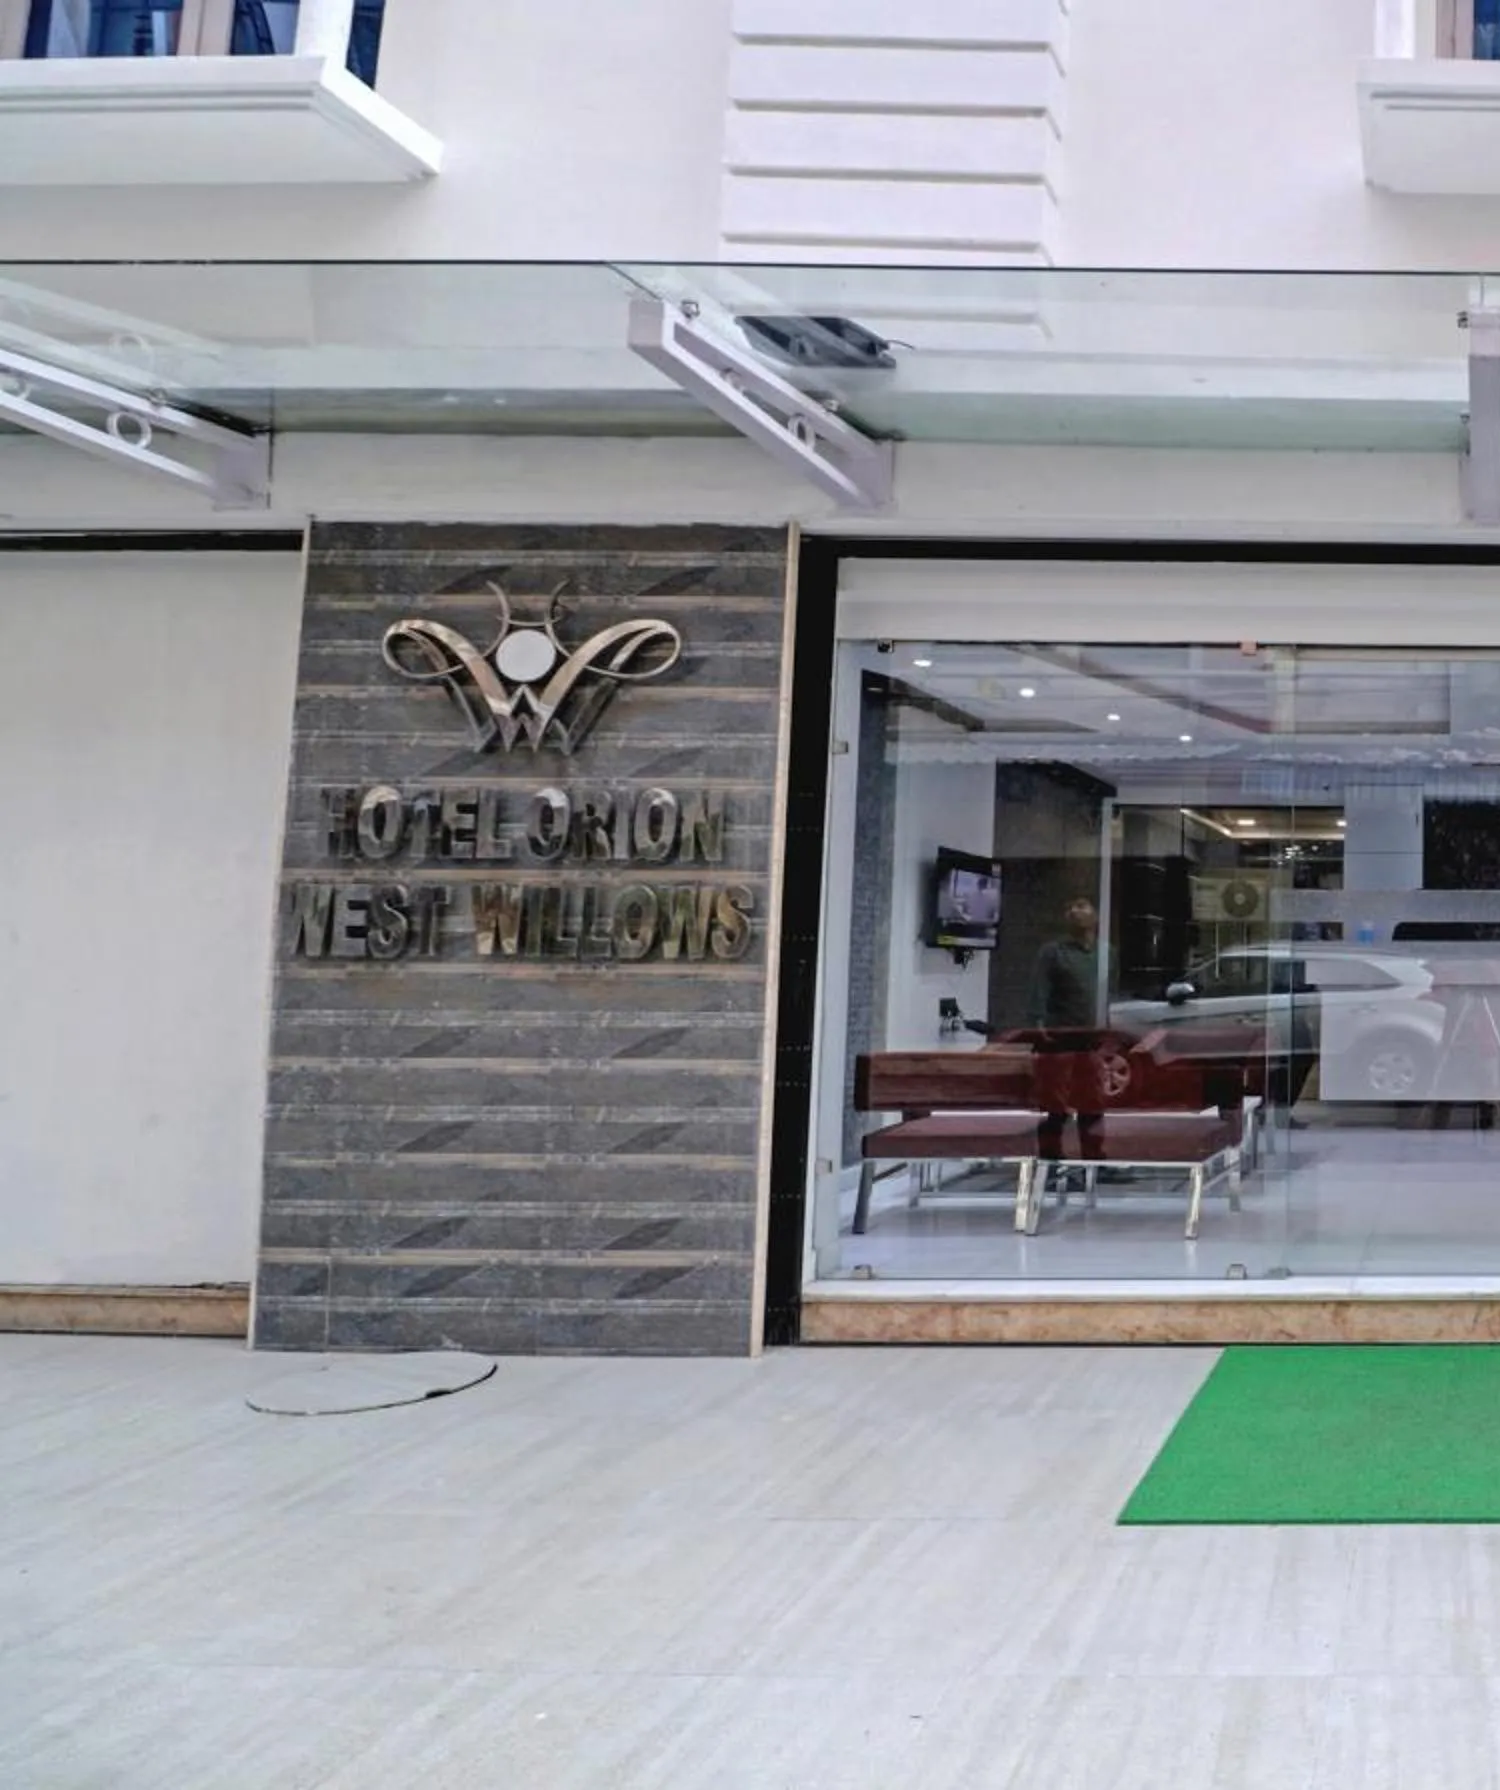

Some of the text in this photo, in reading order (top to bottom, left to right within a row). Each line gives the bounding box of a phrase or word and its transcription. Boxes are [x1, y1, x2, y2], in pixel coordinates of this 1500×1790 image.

[321, 785, 724, 862] HOTEL ORION
[281, 883, 755, 960] WEST WILLOWS
